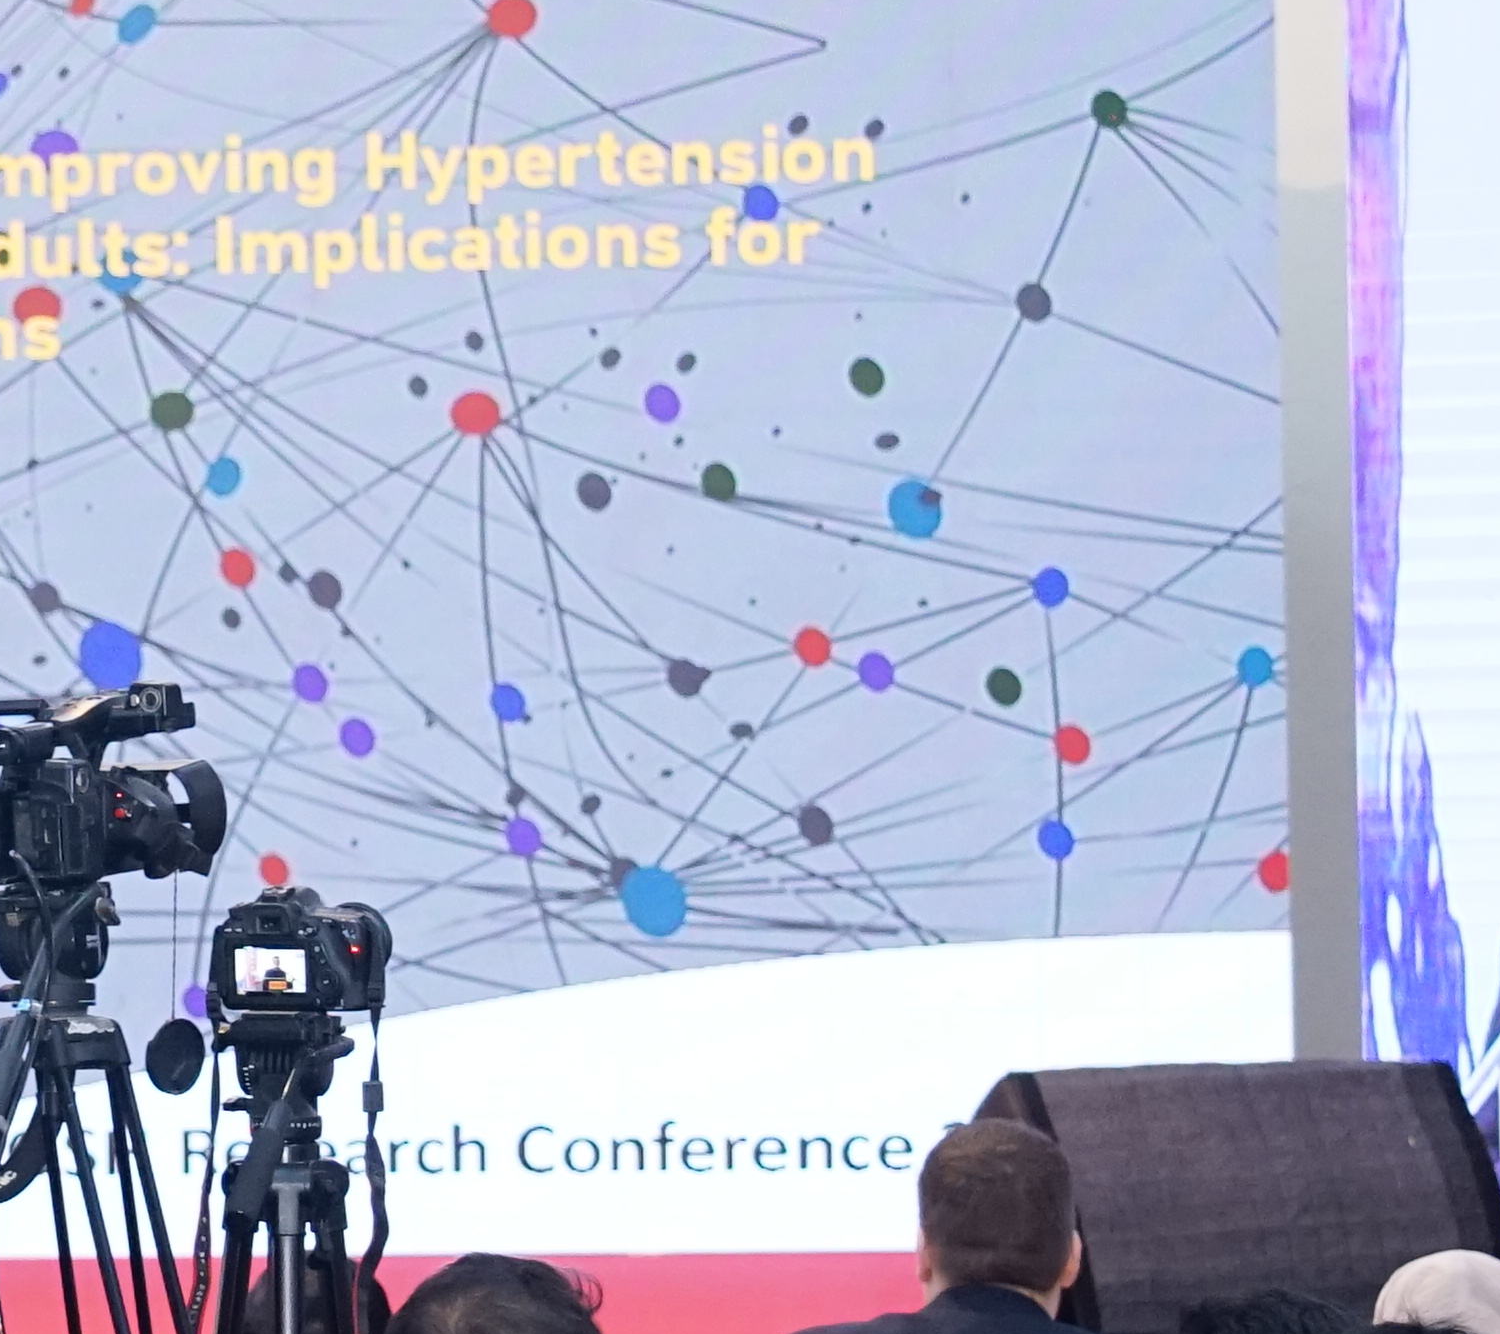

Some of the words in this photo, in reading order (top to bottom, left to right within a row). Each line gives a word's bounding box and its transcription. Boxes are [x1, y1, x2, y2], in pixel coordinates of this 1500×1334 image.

[368, 126, 873, 203] Hypertension
[218, 213, 679, 286] Implications
[707, 208, 818, 264] for
[184, 1124, 486, 1174] Rearch
[517, 1119, 912, 1173] Conference
